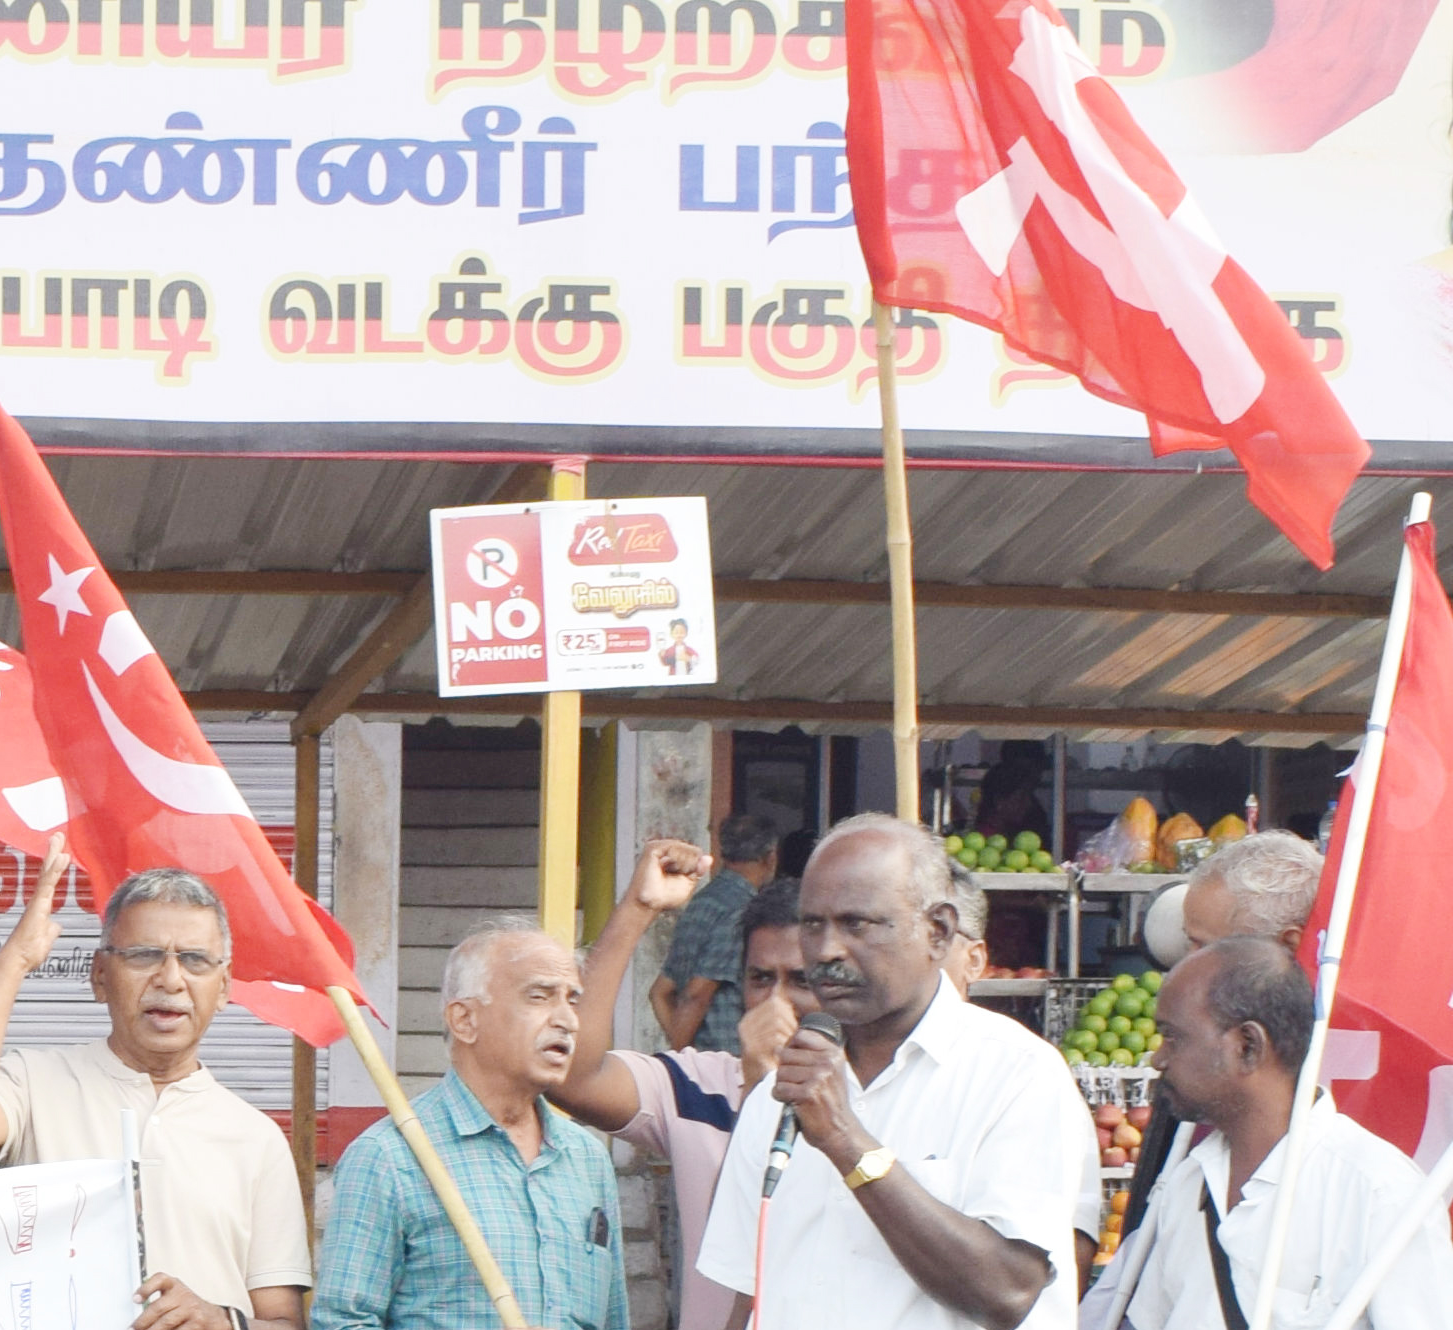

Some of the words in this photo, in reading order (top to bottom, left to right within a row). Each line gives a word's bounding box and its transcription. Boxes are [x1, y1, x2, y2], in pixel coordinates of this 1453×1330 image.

[270, 258, 620, 374] வடக்கு
[450, 597, 542, 643] NO
[451, 644, 543, 663] PARKING
